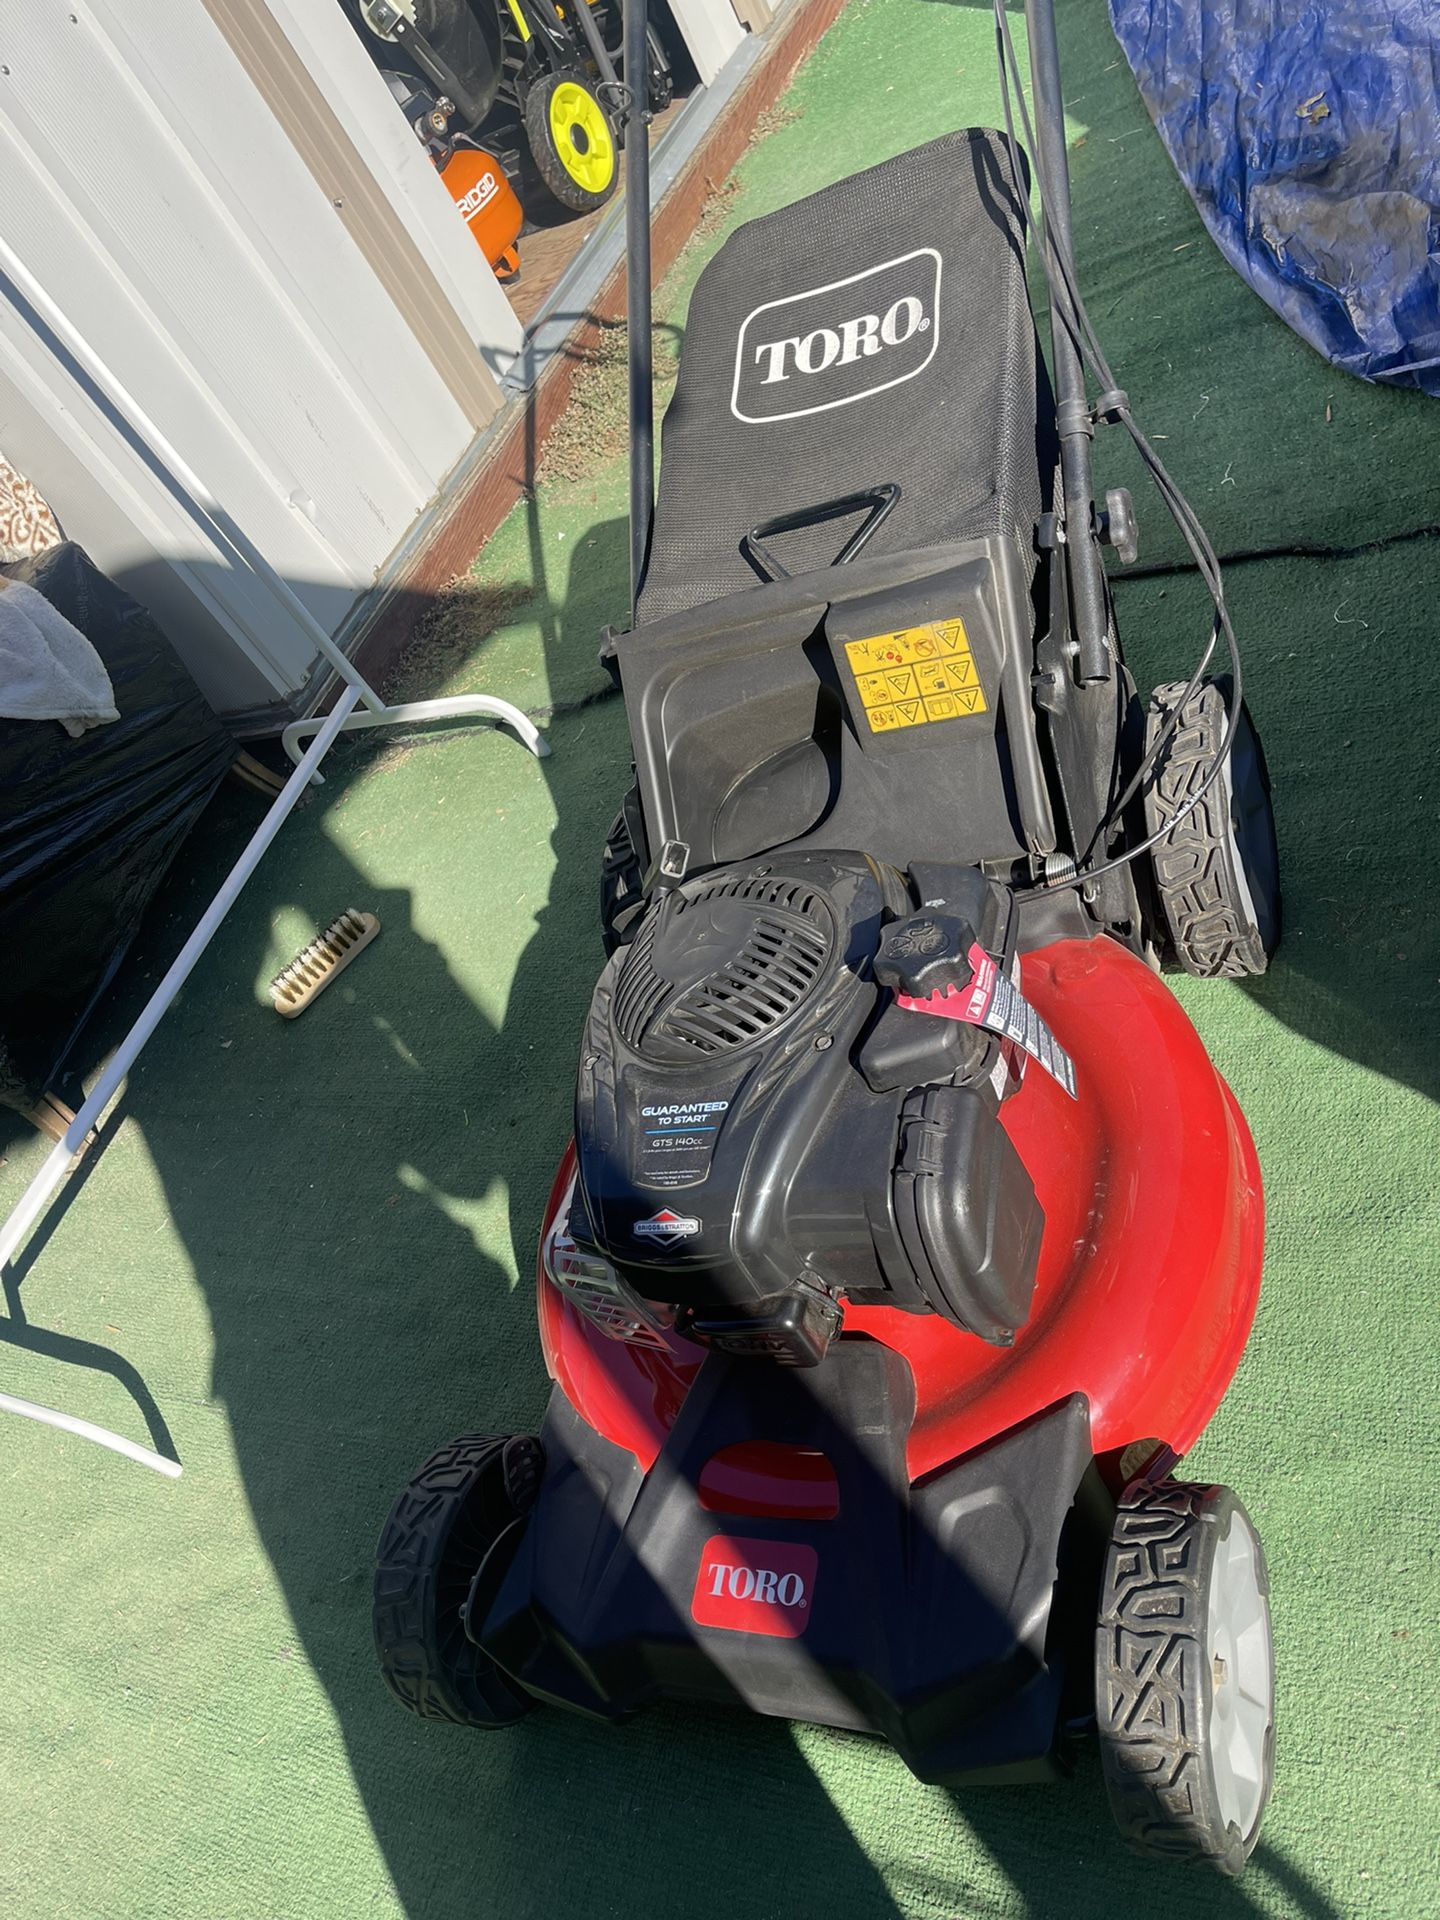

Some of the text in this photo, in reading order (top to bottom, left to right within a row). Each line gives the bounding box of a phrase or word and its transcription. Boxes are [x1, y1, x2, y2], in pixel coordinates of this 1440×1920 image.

[455, 172, 496, 216] RIDGID
[755, 296, 924, 385] TORO
[641, 1101, 729, 1117] GUARANTEED
[658, 1116, 672, 1125] TO
[652, 1137, 703, 1148] GTS 140cc
[708, 1563, 805, 1606] TORO
